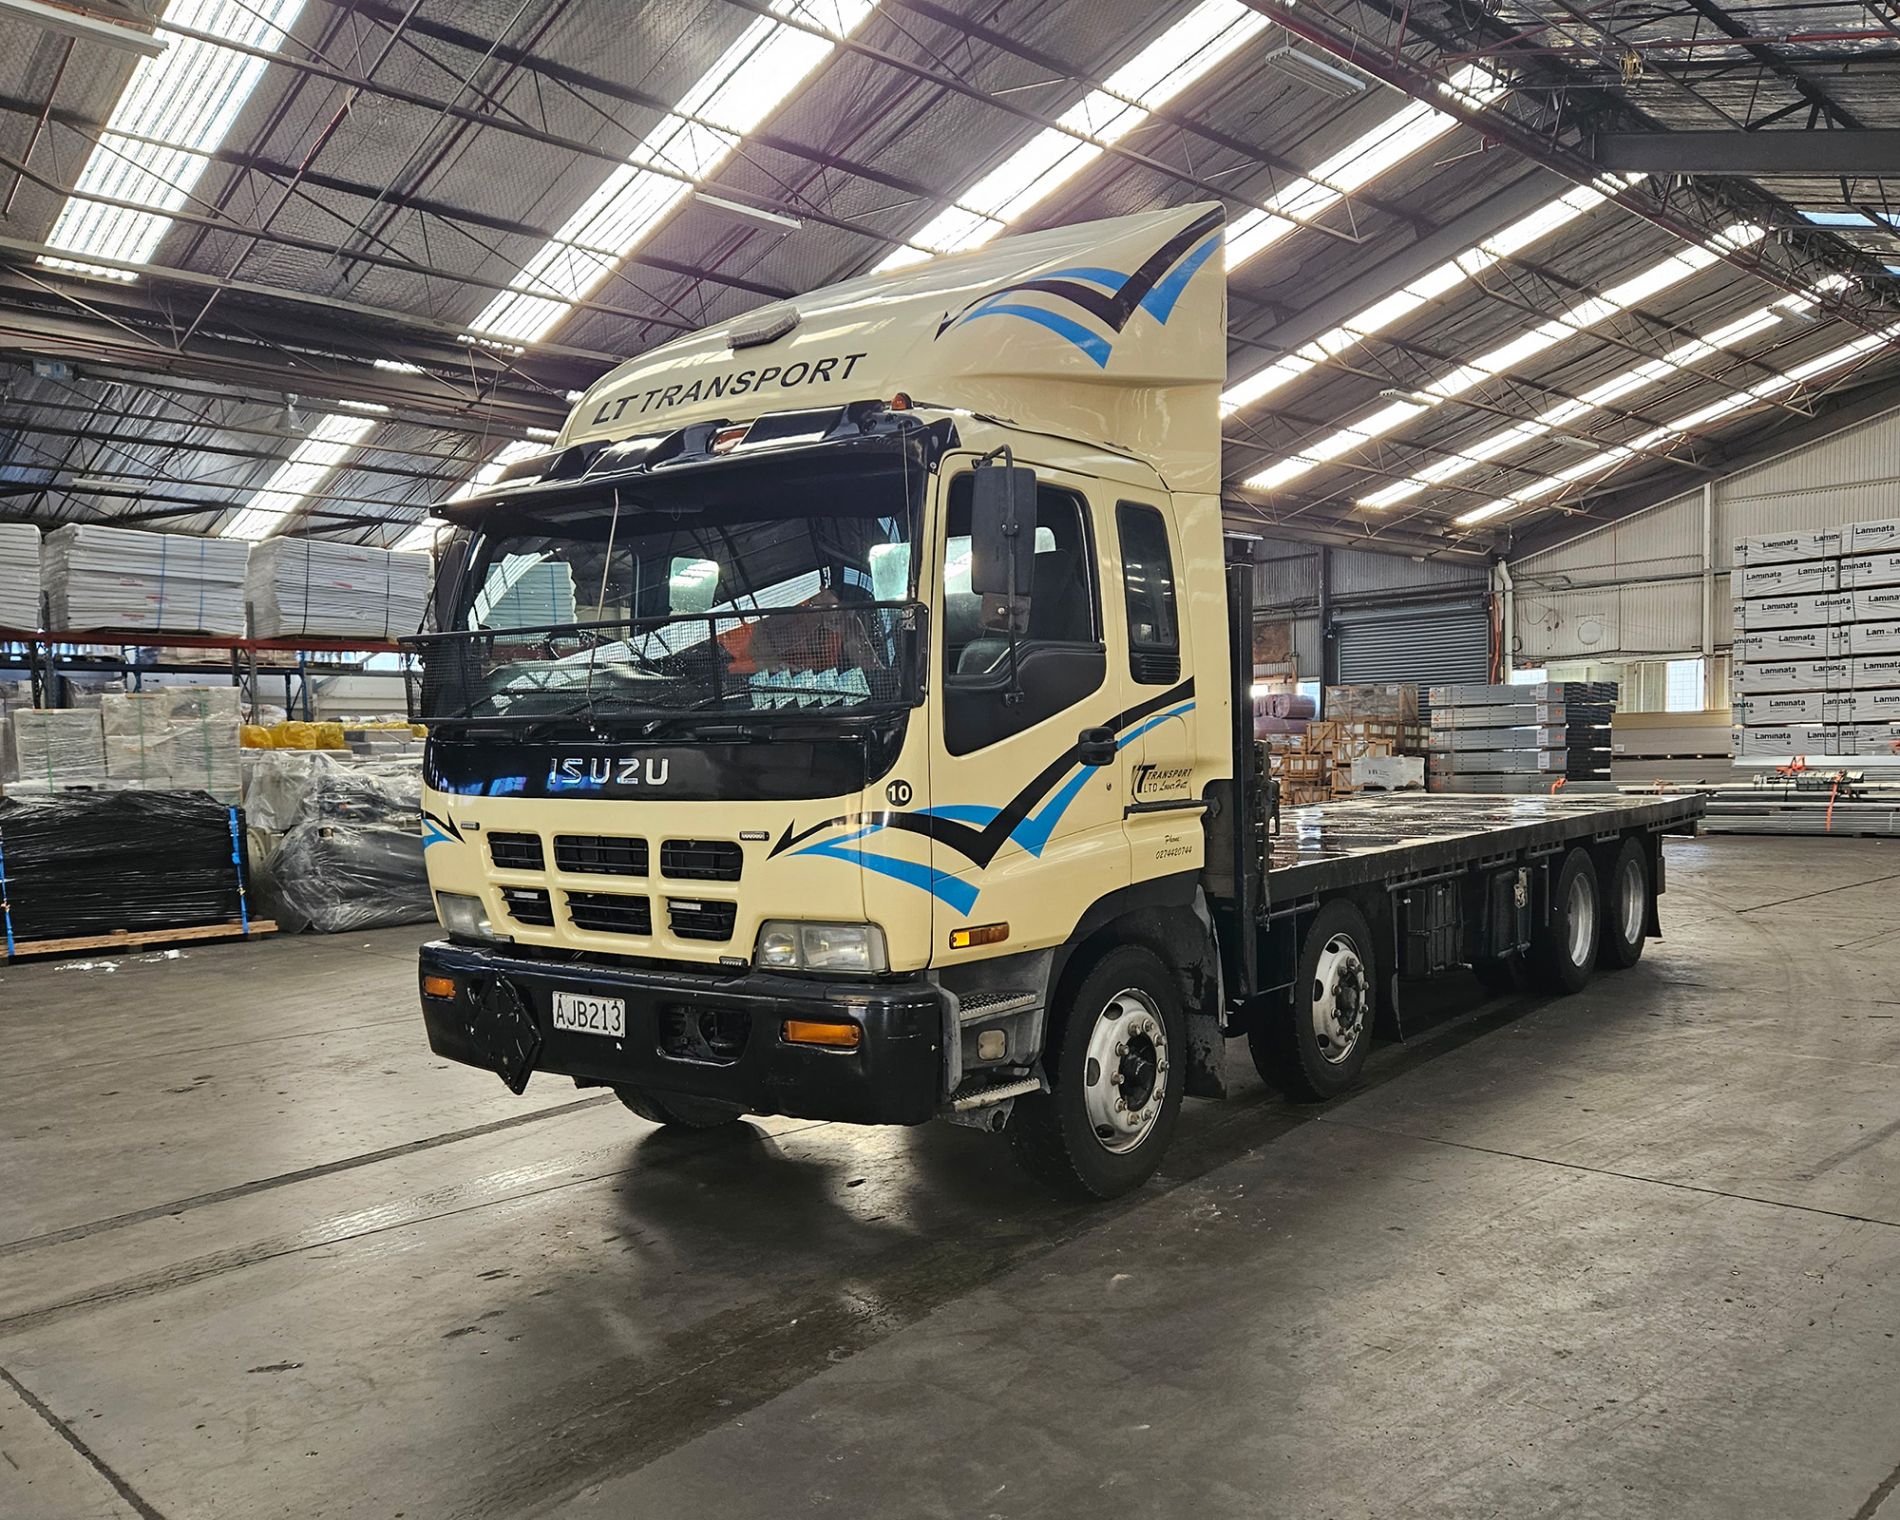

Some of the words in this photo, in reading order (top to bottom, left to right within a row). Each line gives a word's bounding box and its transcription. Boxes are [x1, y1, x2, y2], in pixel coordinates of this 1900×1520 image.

[591, 394, 638, 425] LT
[640, 353, 868, 413] TRANSPORT
[1762, 538, 1799, 549] Laminata
[1855, 524, 1895, 535] Laminata
[1746, 571, 1782, 581] Laminata
[1797, 565, 1836, 576] Laminata
[1762, 601, 1798, 611] Laminata
[1778, 633, 1816, 642] Laminata
[1760, 666, 1797, 675] Laminata
[1769, 699, 1806, 707] Laminata
[1755, 731, 1792, 740] Laminata
[550, 758, 669, 785] ISUZU
[1147, 768, 1193, 780] TRANSPORT
[888, 785, 910, 801] 10
[1143, 783, 1158, 793] LTD
[556, 994, 621, 1032] AJB213
